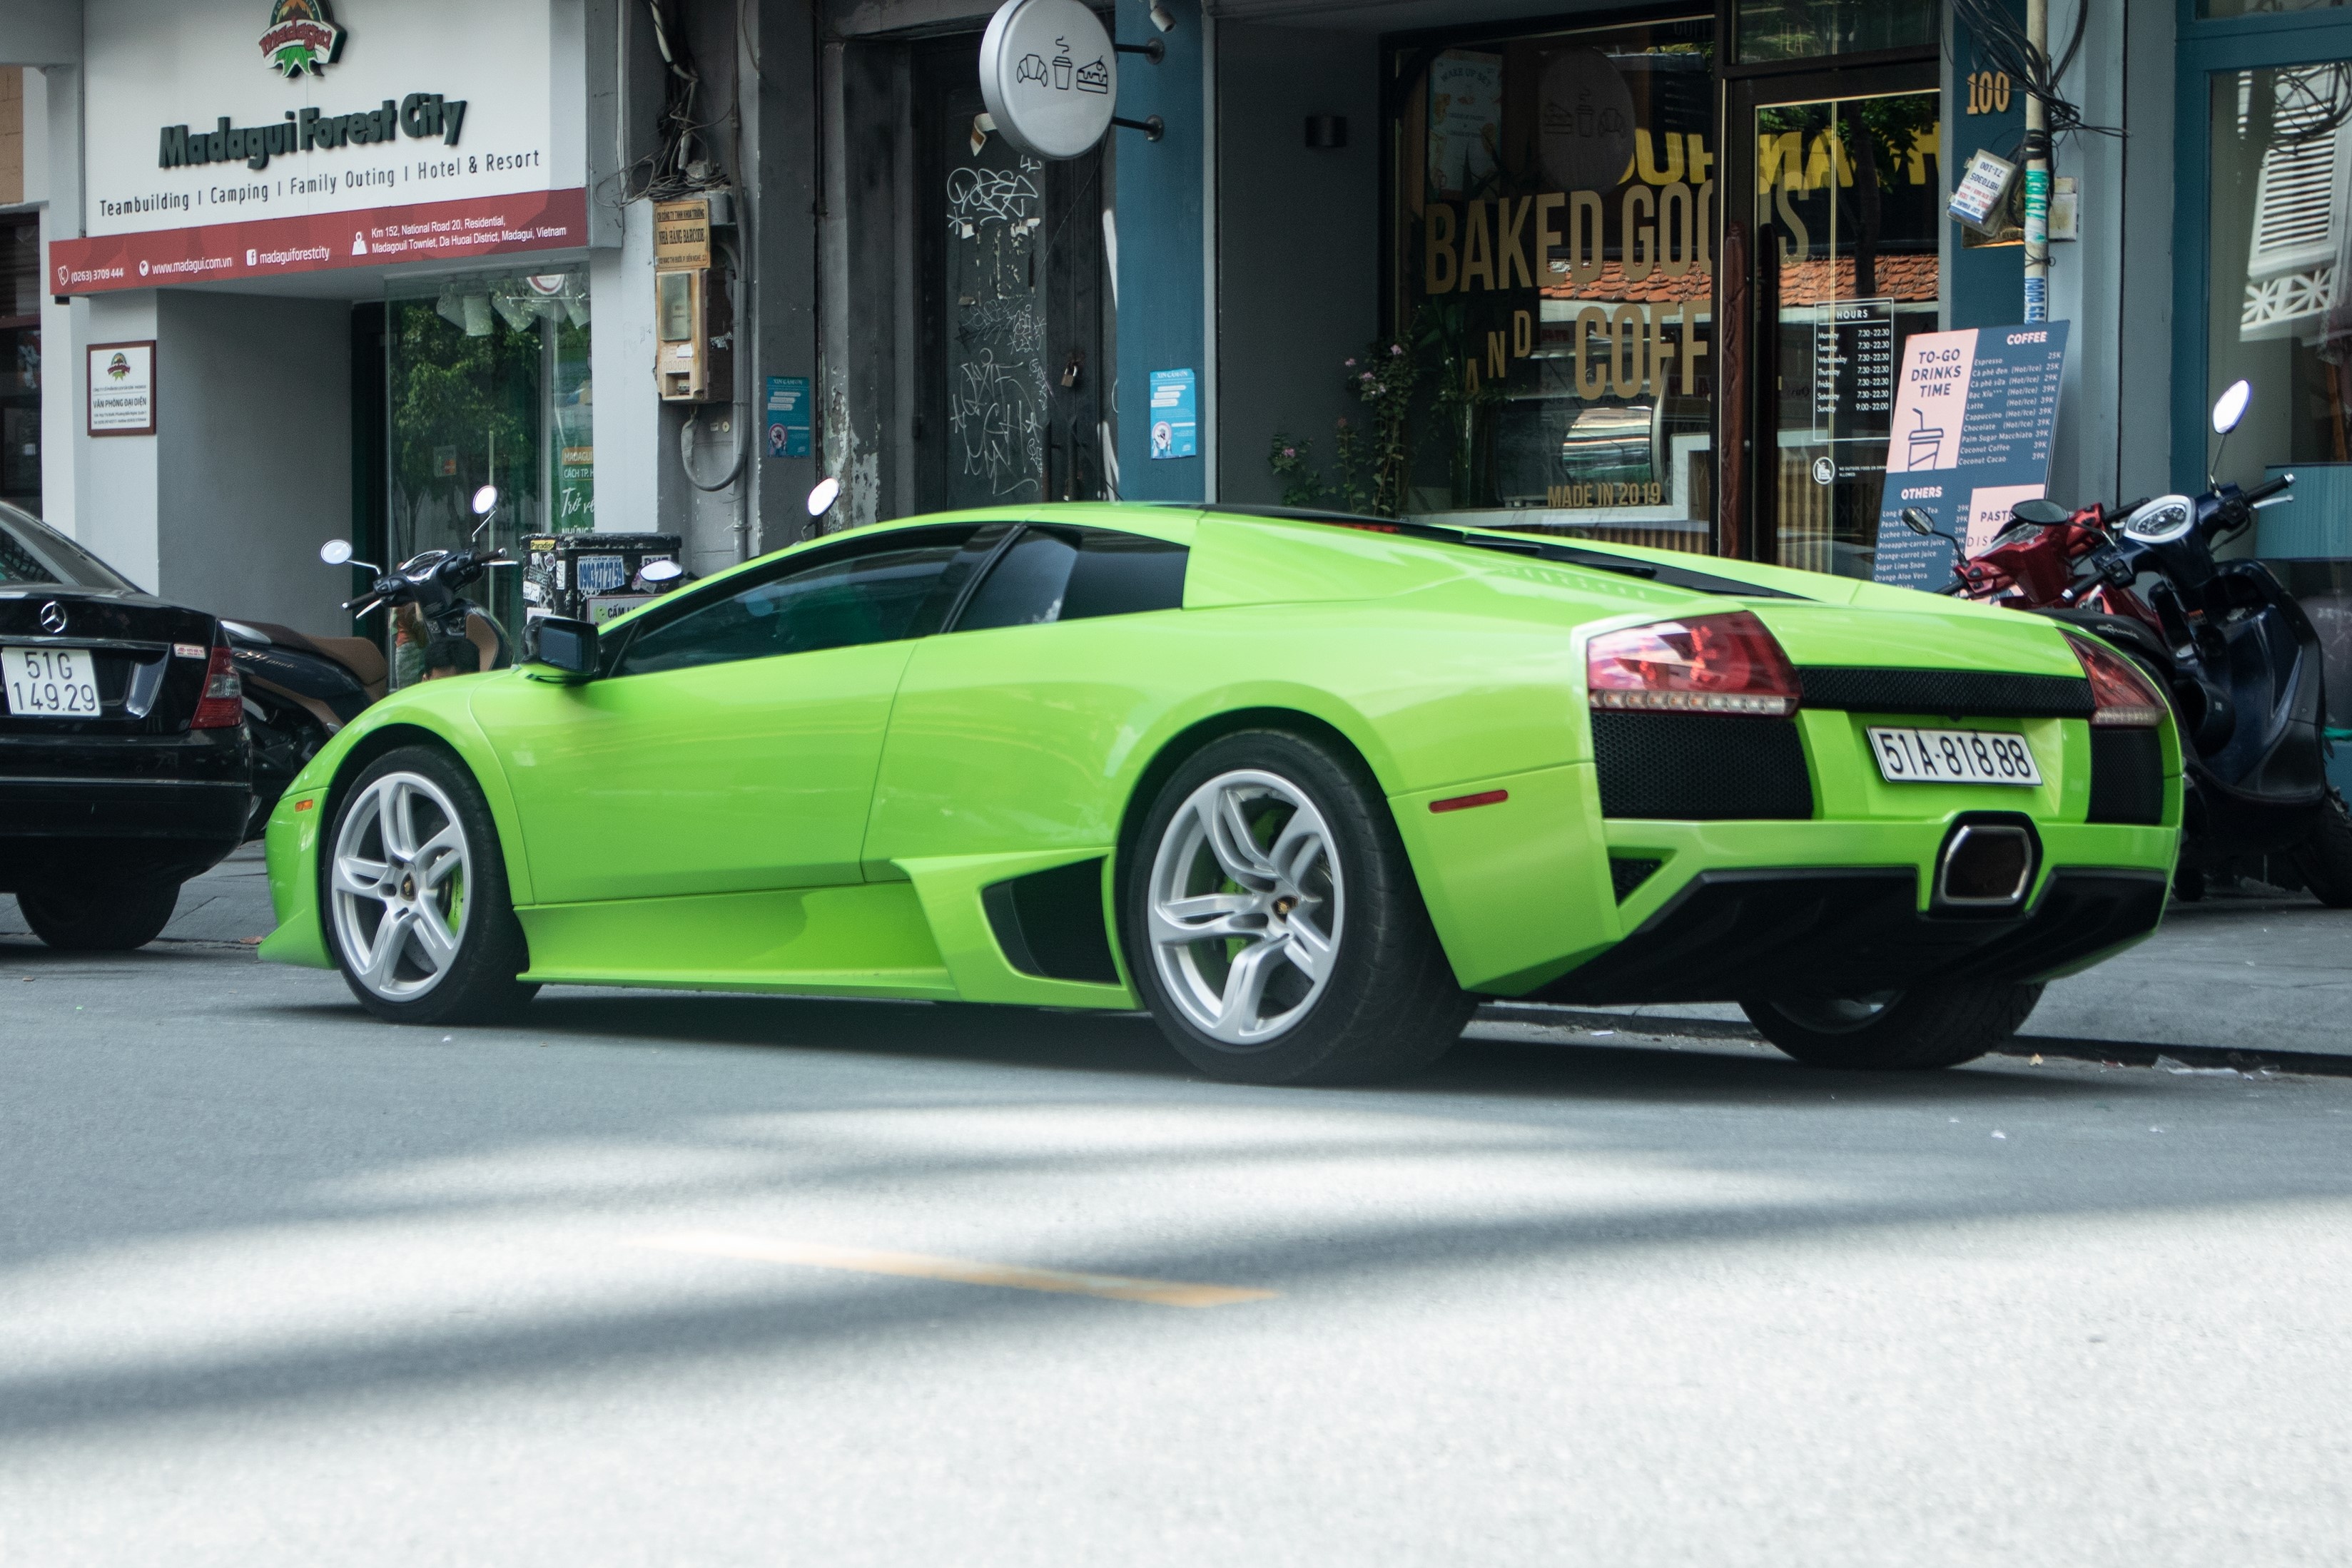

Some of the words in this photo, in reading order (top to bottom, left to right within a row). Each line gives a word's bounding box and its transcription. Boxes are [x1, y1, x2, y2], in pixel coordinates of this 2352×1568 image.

[1967, 71, 2009, 115] 100
[158, 111, 298, 170] Madagui
[298, 100, 397, 151] Forest
[400, 93, 467, 146] City
[100, 193, 188, 216] Teambuilding
[211, 183, 268, 204] Camping
[290, 174, 337, 195] Family
[345, 168, 394, 188] Outing
[418, 158, 460, 179] Hotel
[469, 156, 477, 173] &
[486, 150, 539, 171] Resort
[371, 227, 383, 238] Km
[385, 226, 400, 238] 152,
[401, 223, 429, 236] National
[431, 220, 450, 233] Road
[451, 219, 462, 232] 20,
[465, 215, 505, 230] Residential,
[1426, 190, 1603, 295] BAKED
[1622, 171, 1809, 282] GOS
[409, 237, 437, 250] Townlet,
[440, 235, 450, 247] Da
[451, 233, 472, 245] Huoai
[474, 231, 500, 244] District,
[502, 229, 535, 243] Madagui,
[536, 226, 566, 239] Vietnam
[259, 245, 330, 265] madaguiforestcity
[152, 256, 233, 276] www.madagui.com.vn
[71, 270, 92, 283] (0263)
[93, 269, 110, 280] 3709
[110, 268, 124, 278] 444
[1836, 309, 1868, 320] HOURS
[2007, 331, 2047, 345] COFFEE
[1575, 300, 1713, 401] COFF
[1919, 348, 1960, 364] TO-GO
[1974, 358, 2003, 367] Espresso
[1911, 365, 1962, 382] DRINKS
[1920, 382, 1952, 398] TIME
[1965, 412, 2002, 422] Cappuccino
[1963, 423, 1996, 432] Chocolate
[1999, 432, 2033, 440] Macchiato
[1988, 444, 2010, 452] Coffee
[564, 451, 593, 462] MADAGUI
[1958, 457, 1984, 466] Coconut
[1547, 484, 1593, 509] MADE
[1598, 482, 1614, 506] IN
[1618, 482, 1661, 506] 2019
[1901, 487, 1942, 500] OTHERS
[1878, 540, 1929, 549] Pineapple-carrot
[1930, 539, 1946, 548] juice
[1877, 552, 1920, 561] Orange-carrot
[1921, 551, 1937, 559] juice
[24, 651, 72, 680] 51G
[14, 683, 96, 712] 149.29
[1877, 733, 2032, 778] 51A-818.88
